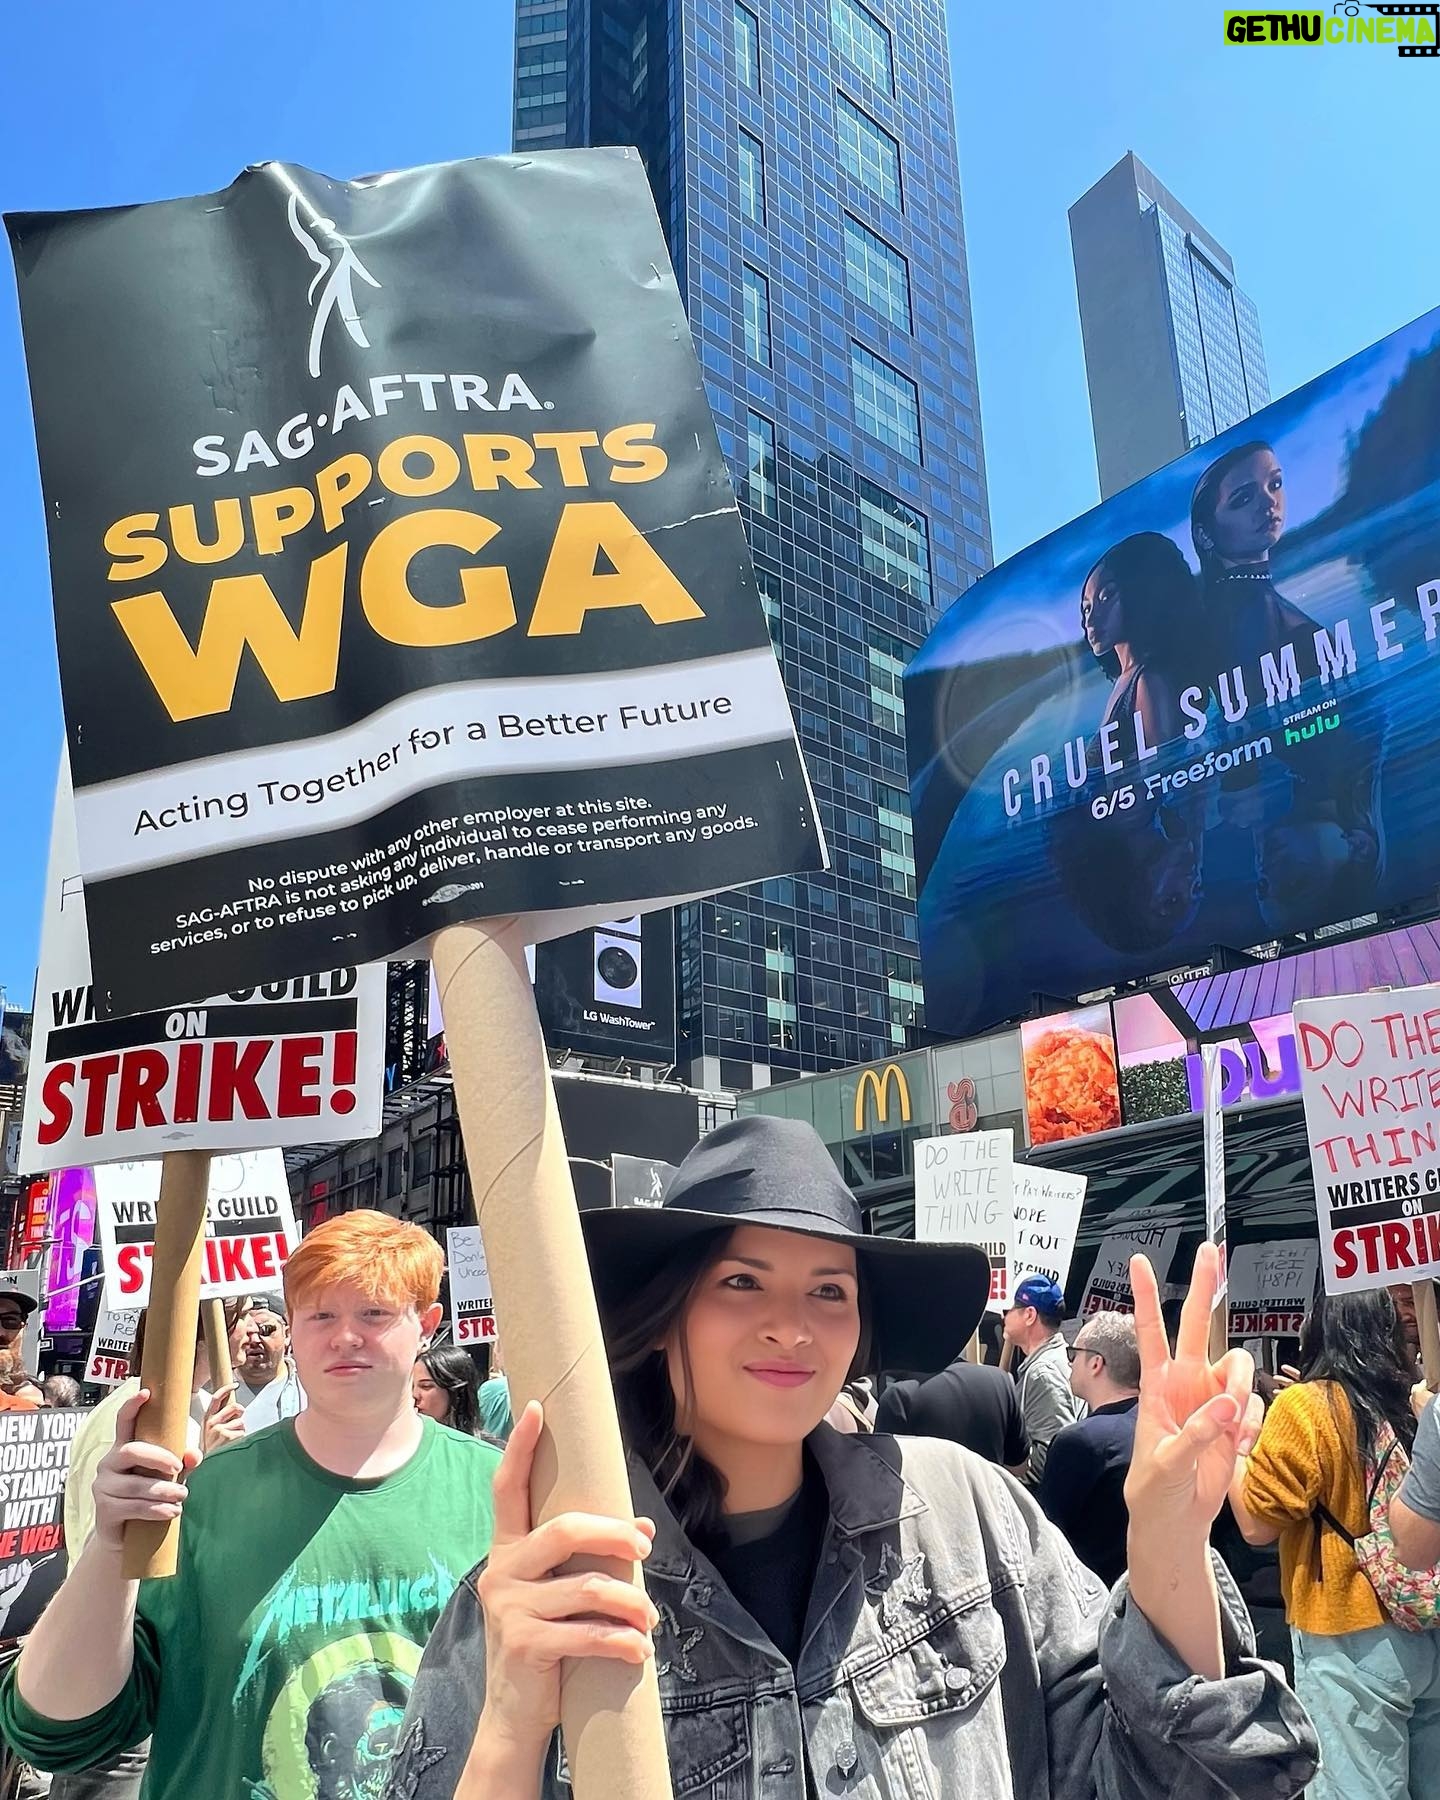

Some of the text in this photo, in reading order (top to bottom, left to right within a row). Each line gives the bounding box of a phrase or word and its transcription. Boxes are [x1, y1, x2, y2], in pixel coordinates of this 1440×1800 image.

[103, 423, 668, 582] SUPPORTS
[110, 501, 707, 723] WGA
[1001, 578, 1440, 818] CRUEL SUMMER
[1282, 698, 1337, 727] STREAM ON
[134, 696, 733, 836] Acting Together for a Better Future
[1090, 713, 1340, 820] 6/5 Freeform hulu
[175, 802, 727, 930] SAG-AFTRA is not asking any individual to cease performing any
[247, 796, 652, 894] No dispute with any other employer at this site.
[150, 815, 759, 955] services, or to refuse to pick up, deliver, handle or transport any goods.
[165, 1010, 208, 1039] ON
[583, 1009, 598, 1021] LG
[1299, 1009, 1440, 1072] DO THE
[37, 1031, 359, 1146] STRIKE!
[1322, 1067, 1440, 1119] WRITE
[925, 1137, 1001, 1170] DO THE
[1314, 1121, 1438, 1173] THIN
[933, 1167, 1001, 1200] WRITE
[1327, 1171, 1420, 1208] WRITERS
[217, 1196, 278, 1218] GUILD
[924, 1200, 1005, 1235] THING
[1401, 1199, 1423, 1217] ON
[451, 1231, 474, 1248] Be
[1029, 1234, 1067, 1250] OUT
[3, 1497, 57, 1529] WITH
